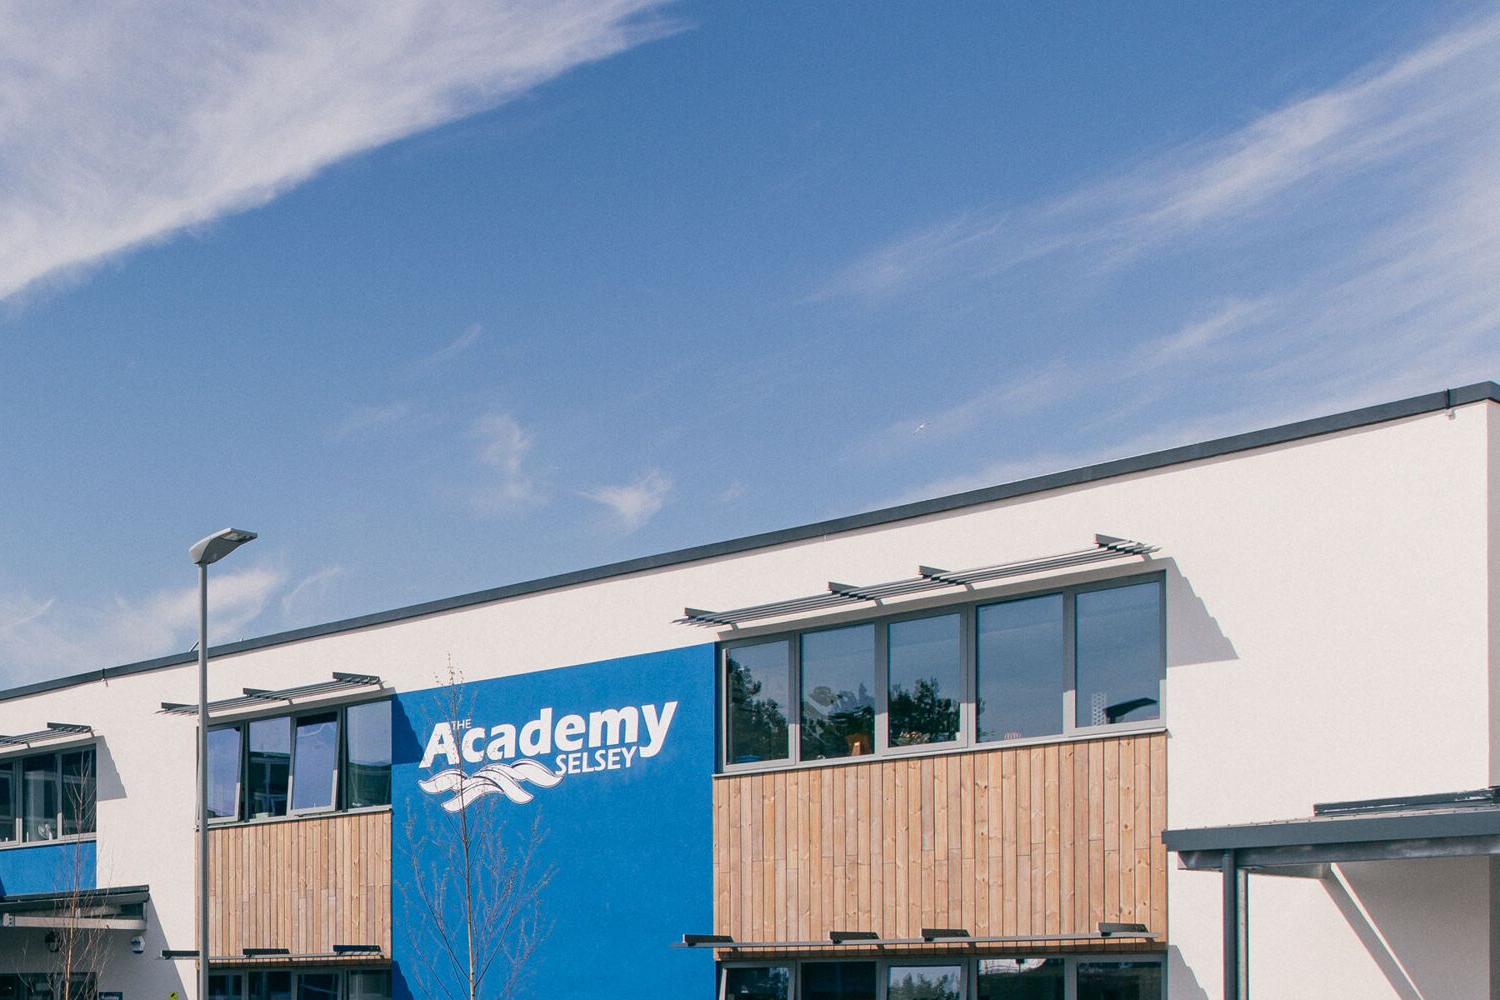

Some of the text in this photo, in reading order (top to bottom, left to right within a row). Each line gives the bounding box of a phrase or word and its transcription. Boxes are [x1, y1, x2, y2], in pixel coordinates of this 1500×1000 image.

[419, 700, 678, 768] Academy
[451, 719, 472, 730] THE
[555, 746, 637, 775] SELSEY
